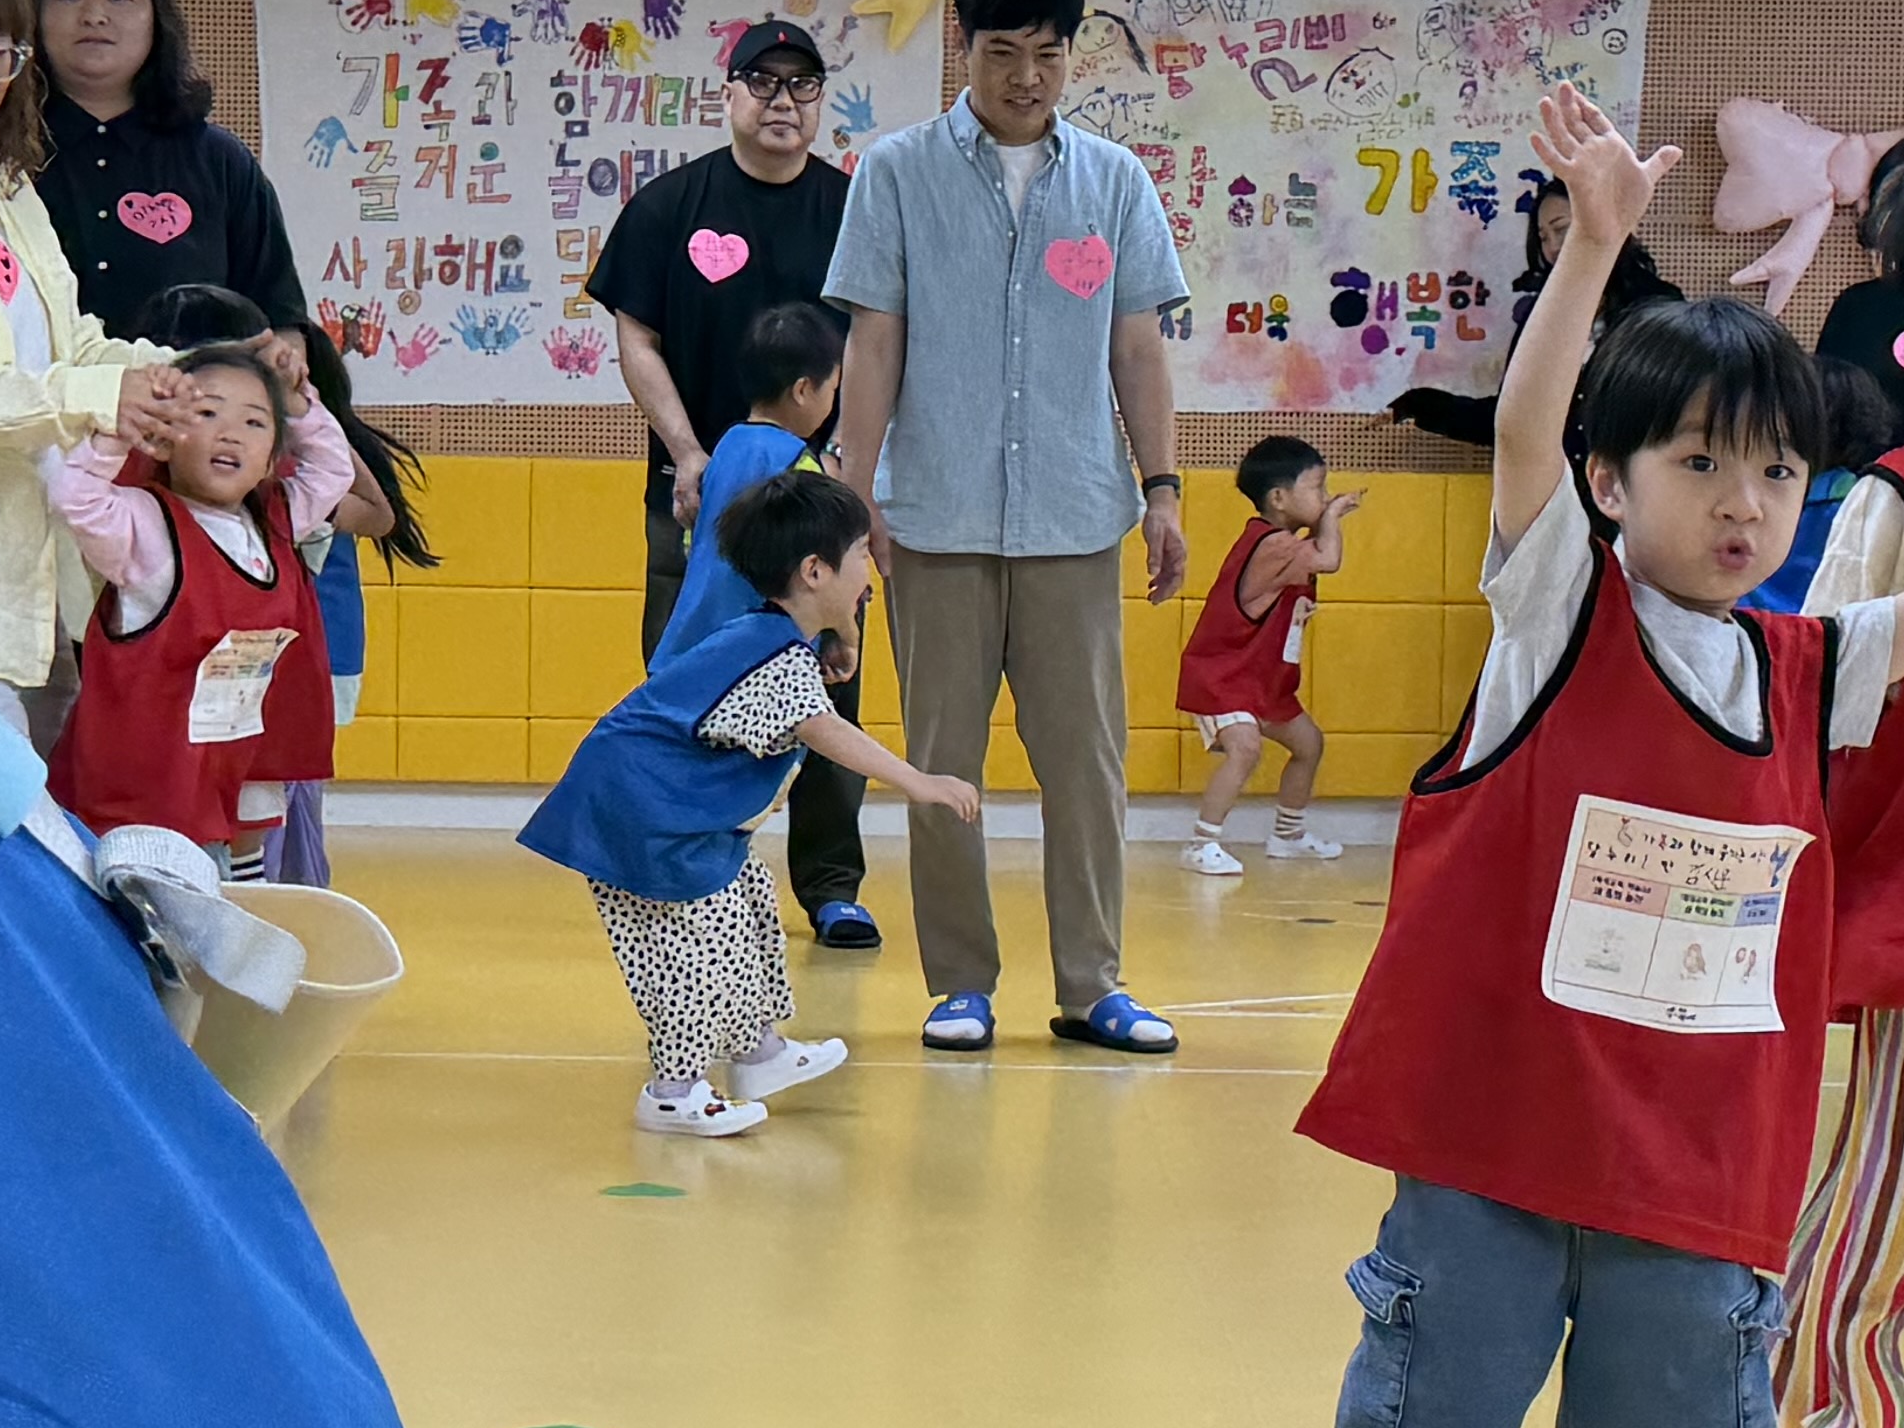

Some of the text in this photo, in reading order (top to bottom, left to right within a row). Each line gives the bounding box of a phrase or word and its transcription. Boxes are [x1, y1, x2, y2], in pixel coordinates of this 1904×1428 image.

[351, 139, 513, 222] 즐거운
[322, 233, 531, 316] 사랑해요
[1225, 293, 1292, 342] 더욱
[1329, 266, 1492, 355] 행복한
